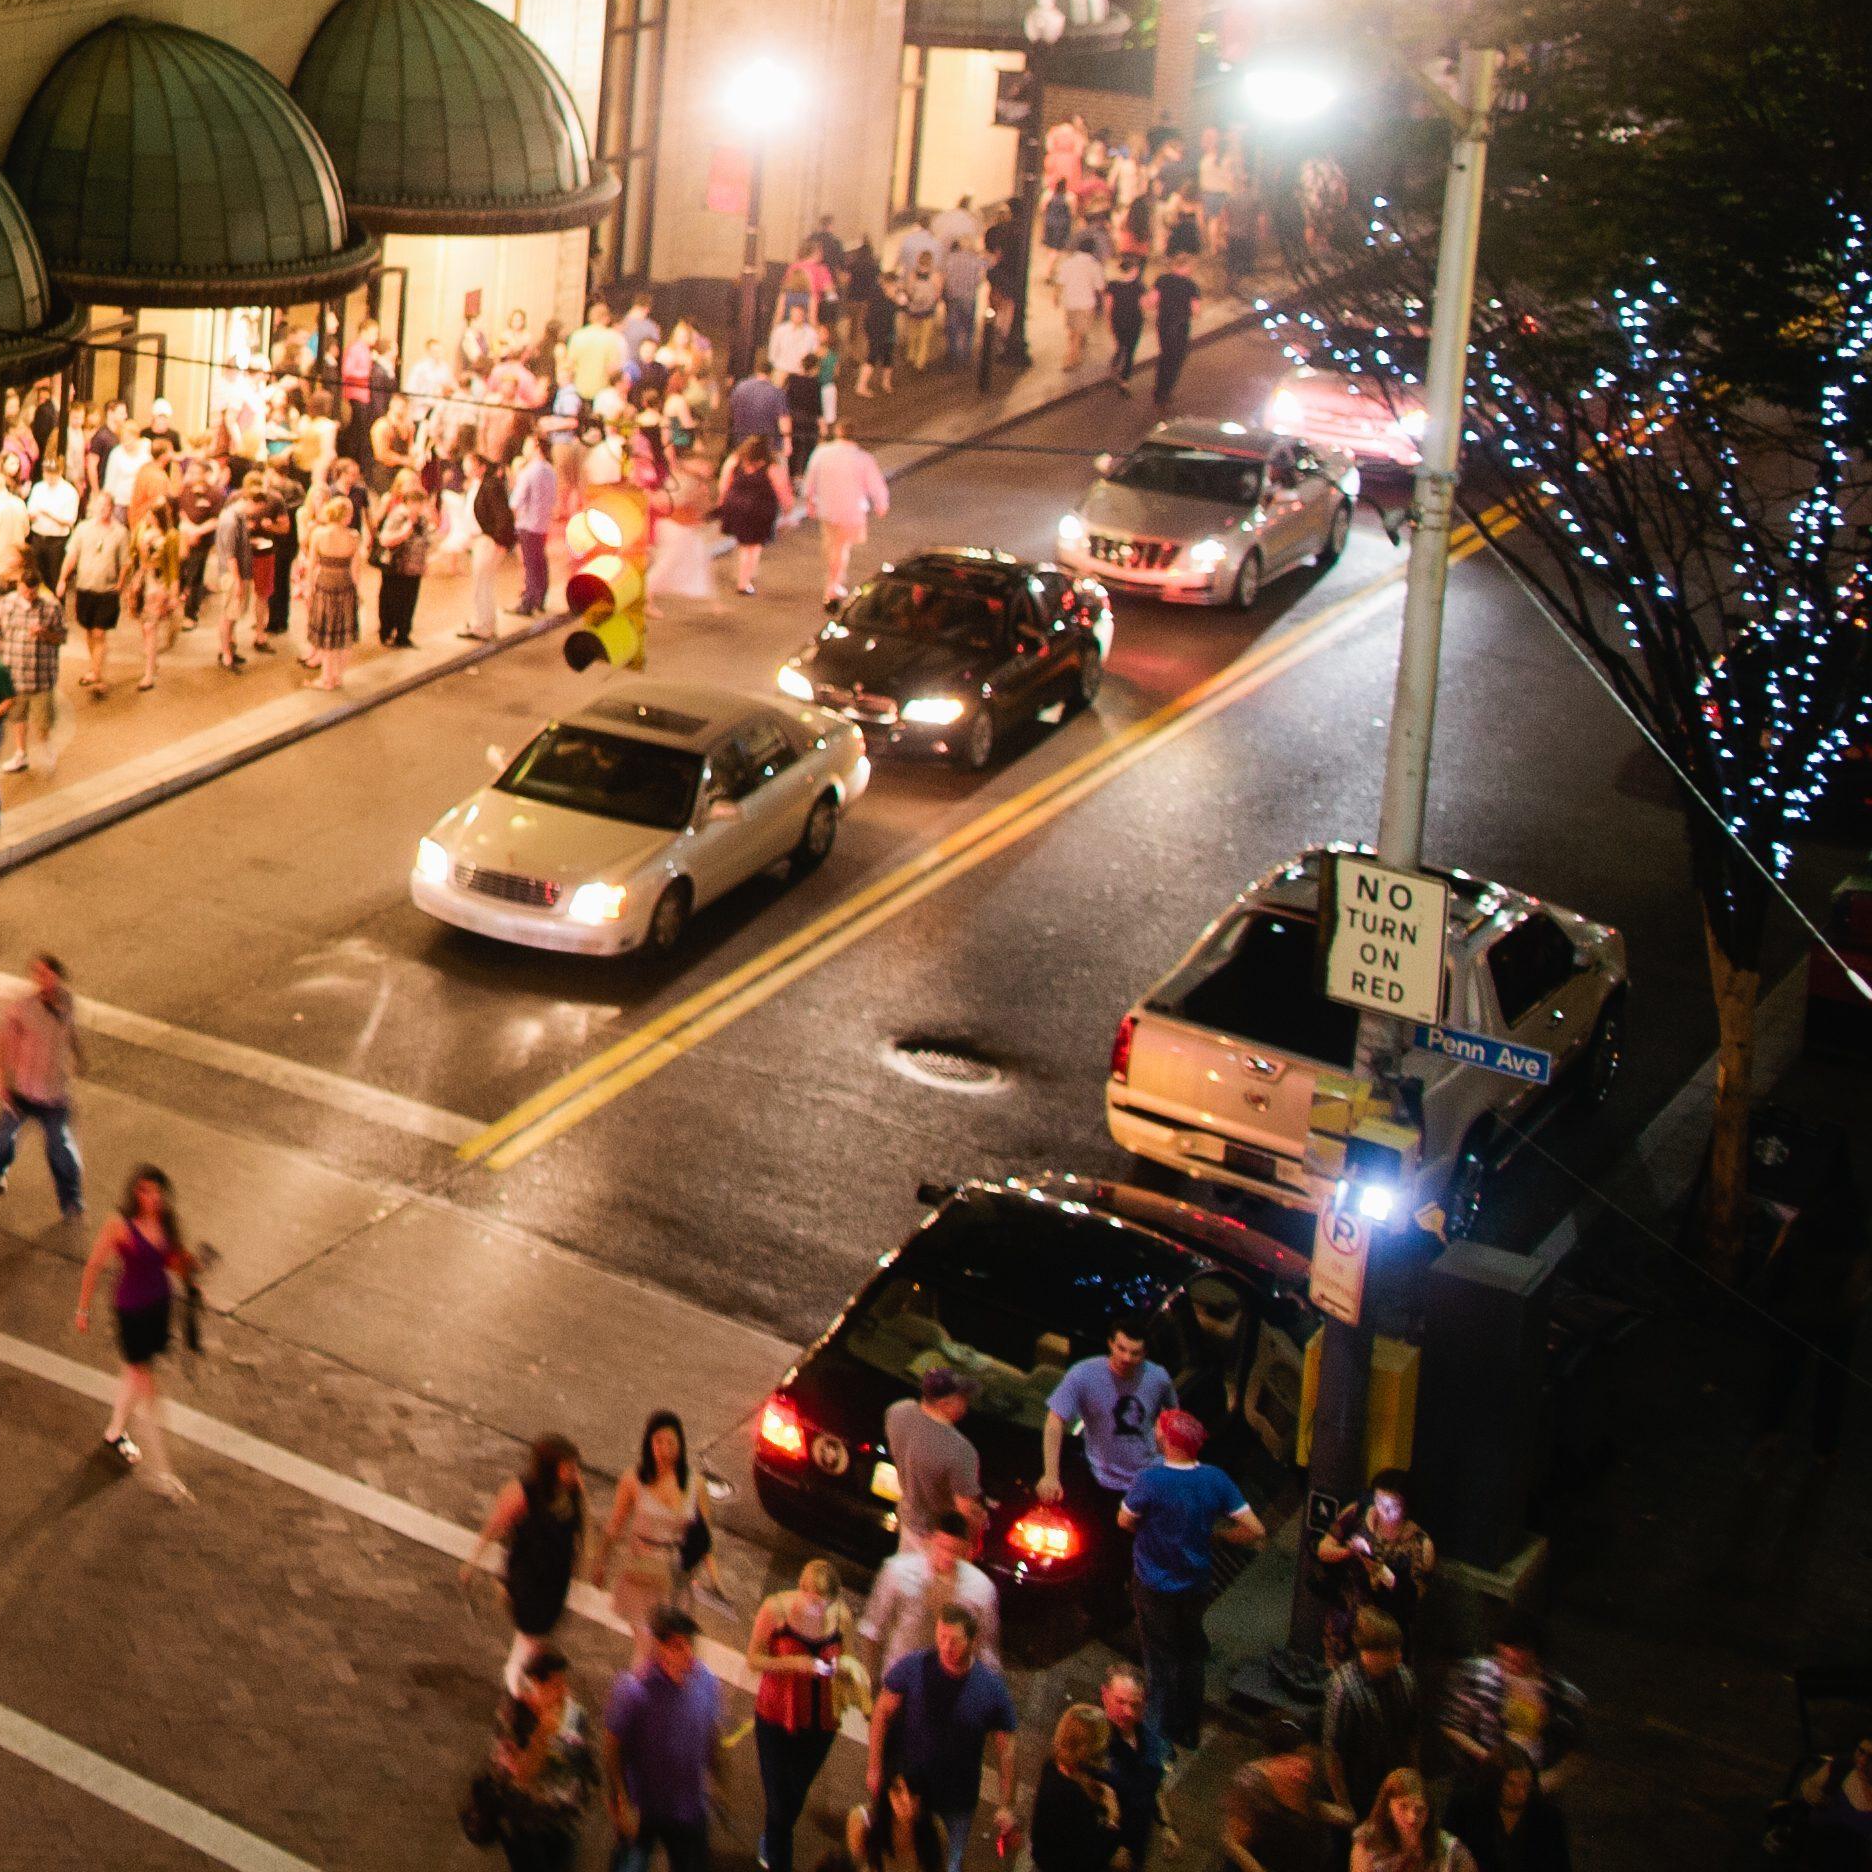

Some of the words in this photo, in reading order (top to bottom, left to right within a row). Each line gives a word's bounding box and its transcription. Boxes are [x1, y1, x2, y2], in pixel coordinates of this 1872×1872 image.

[1357, 873, 1413, 912] NO
[1346, 905, 1418, 946] TURN
[1359, 942, 1401, 972] ON
[1351, 971, 1405, 1004] RED
[1427, 1027, 1486, 1062] Penn
[1496, 1047, 1541, 1077] Ave
